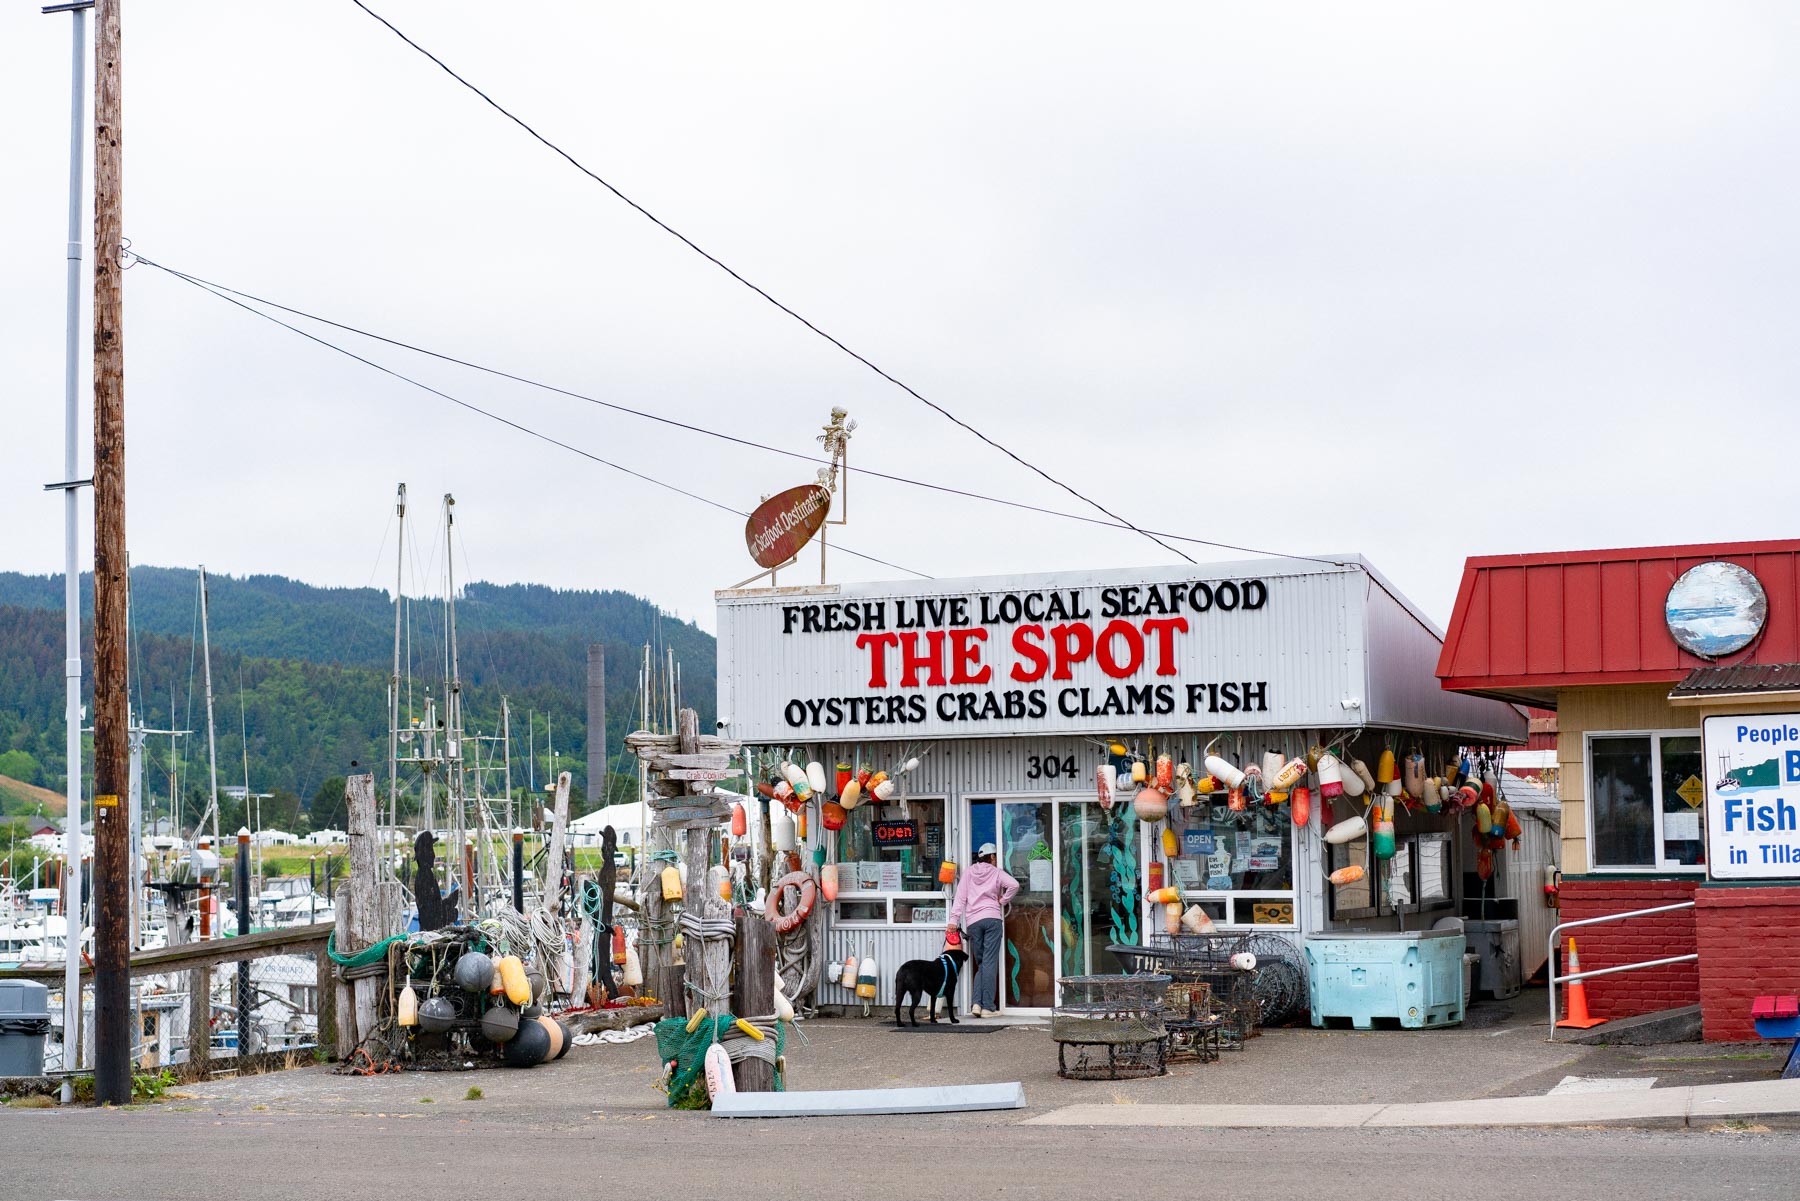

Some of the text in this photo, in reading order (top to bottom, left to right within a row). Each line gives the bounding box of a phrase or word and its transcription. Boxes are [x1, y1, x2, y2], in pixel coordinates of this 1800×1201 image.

[755, 518, 785, 549] Seafood
[780, 487, 830, 531] Destination
[783, 580, 1268, 634] FRESH LIVE LOCAL SEAFOOD
[856, 617, 1189, 688] THE SPOT
[785, 682, 1268, 728] OYSTERS CRABS CLAMS FISH
[686, 771, 702, 780] Crab
[1027, 755, 1080, 779] 304
[1724, 798, 1797, 832] Fish
[877, 826, 912, 841] Open
[1187, 834, 1212, 844] OPEN
[1729, 846, 1748, 865] in
[1135, 955, 1165, 971] THE
